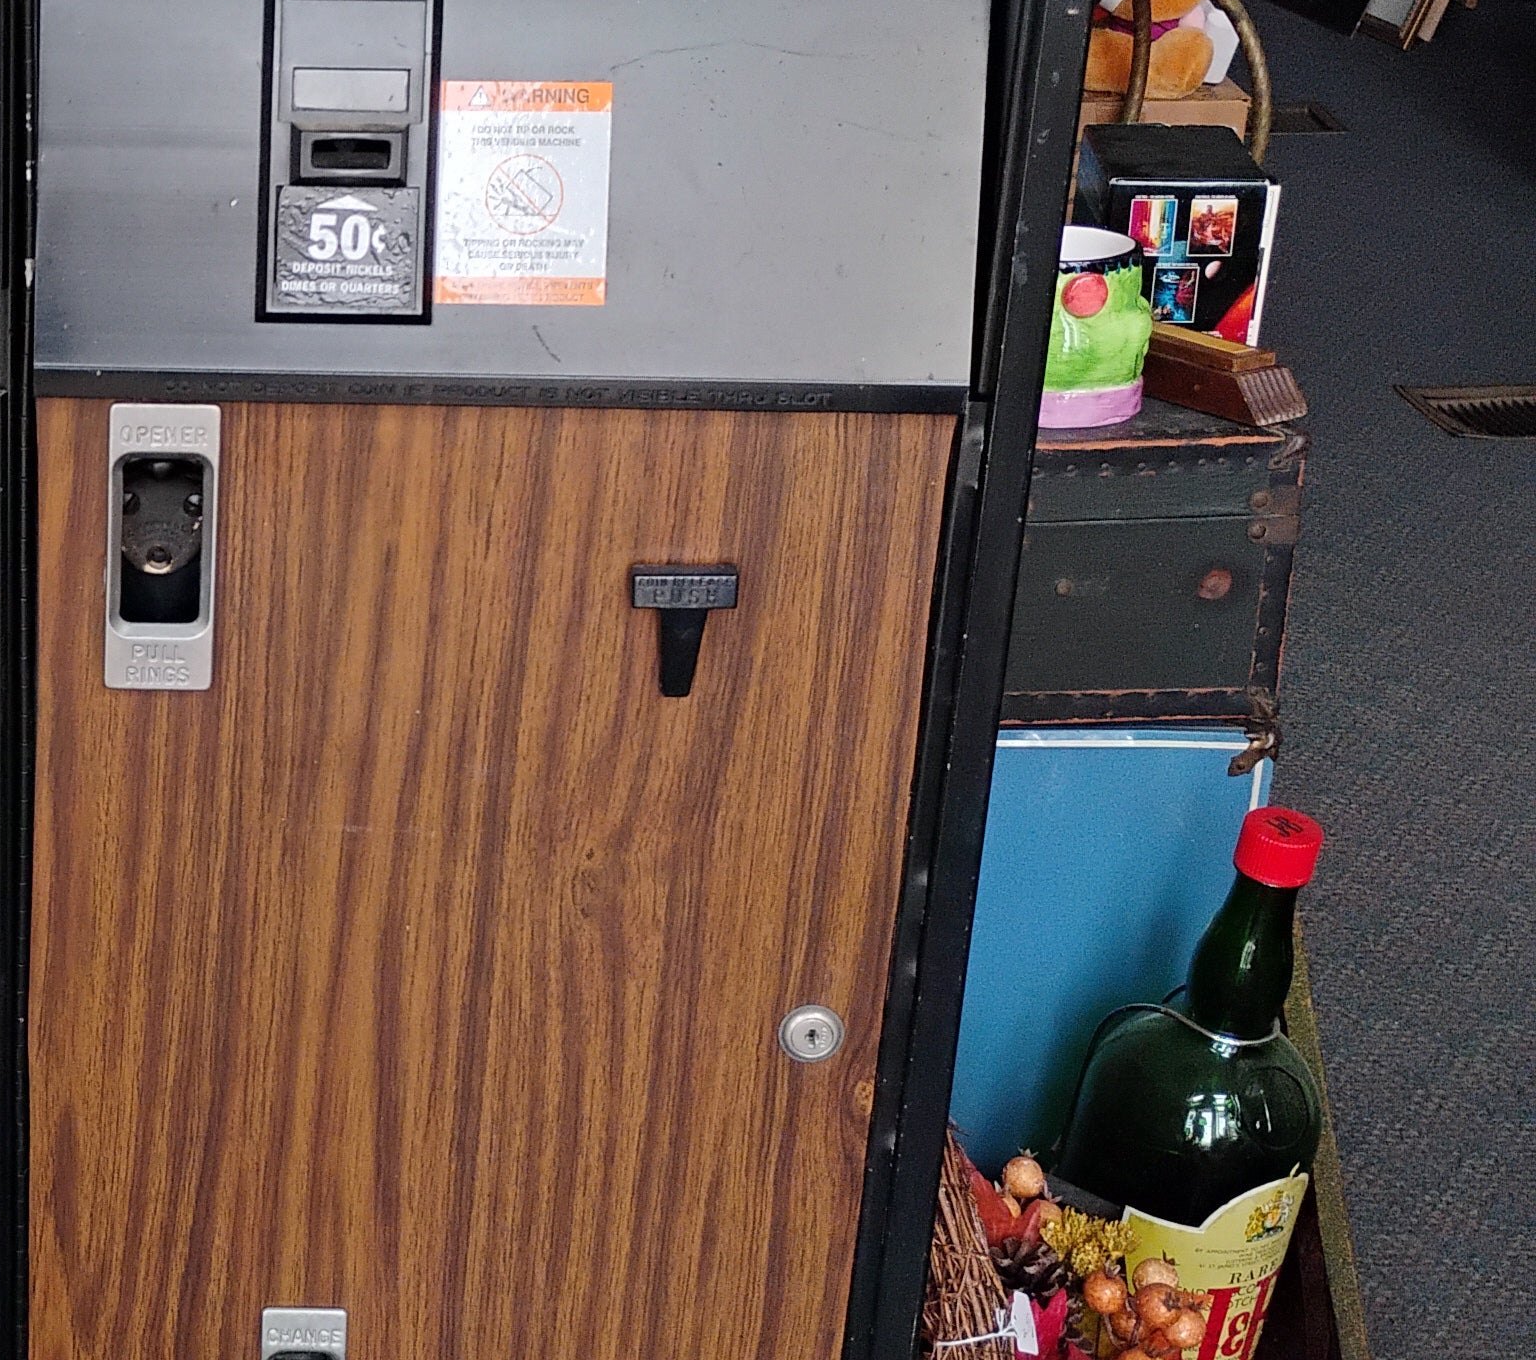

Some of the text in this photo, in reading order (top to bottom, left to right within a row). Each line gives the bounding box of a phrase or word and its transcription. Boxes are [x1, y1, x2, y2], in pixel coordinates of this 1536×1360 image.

[308, 213, 387, 261] 50¢
[292, 262, 394, 276] DEPOSIT NICKELS
[281, 280, 401, 295] DIMES OR QUARTERS
[119, 424, 209, 447] OPENER
[131, 643, 186, 663] PULL
[125, 665, 191, 686] RINGS
[1228, 1257, 1279, 1285] RARE
[267, 1327, 343, 1347] CHANGE
